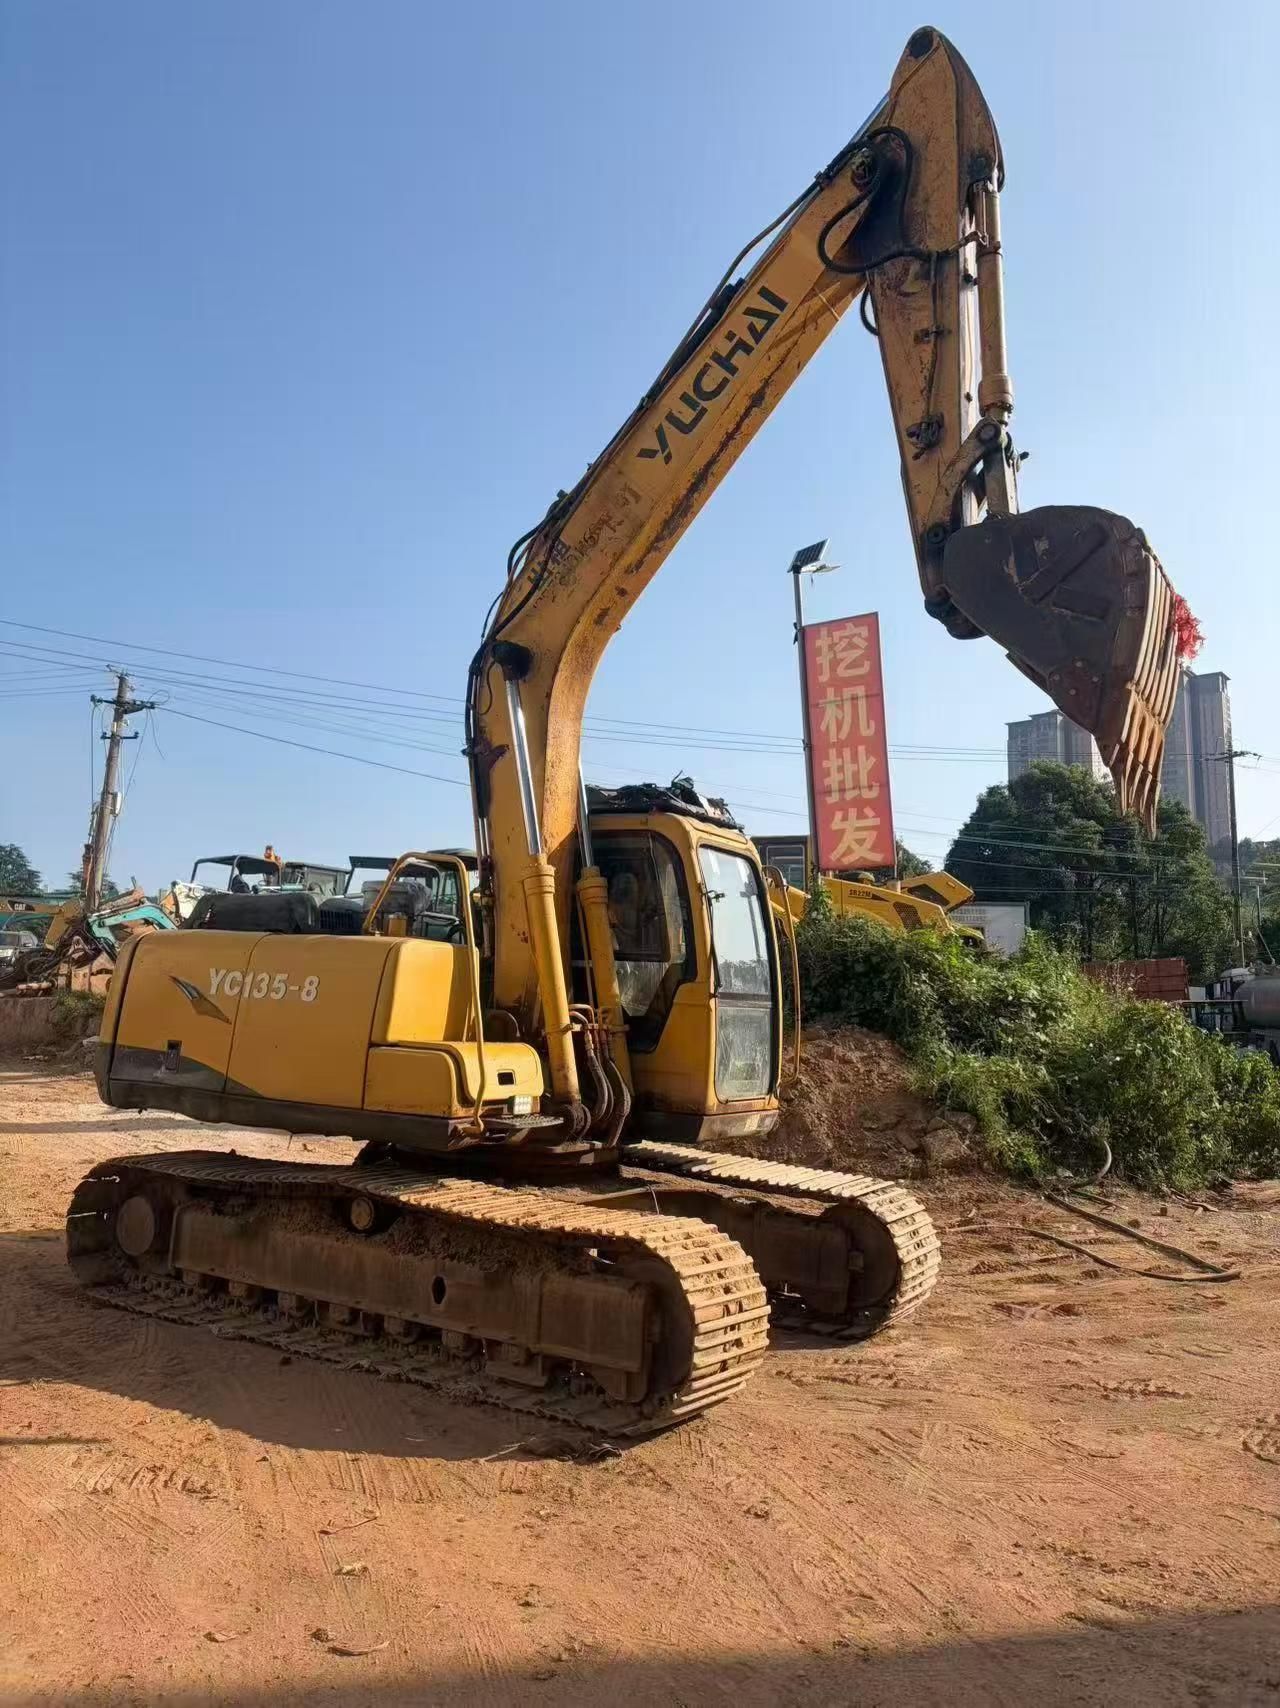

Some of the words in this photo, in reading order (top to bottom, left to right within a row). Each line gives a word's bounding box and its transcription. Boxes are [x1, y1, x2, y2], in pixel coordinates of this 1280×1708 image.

[636, 286, 788, 465] YUCHAI
[816, 622, 885, 866] 挖机批发
[208, 968, 320, 1002] YC135-8
